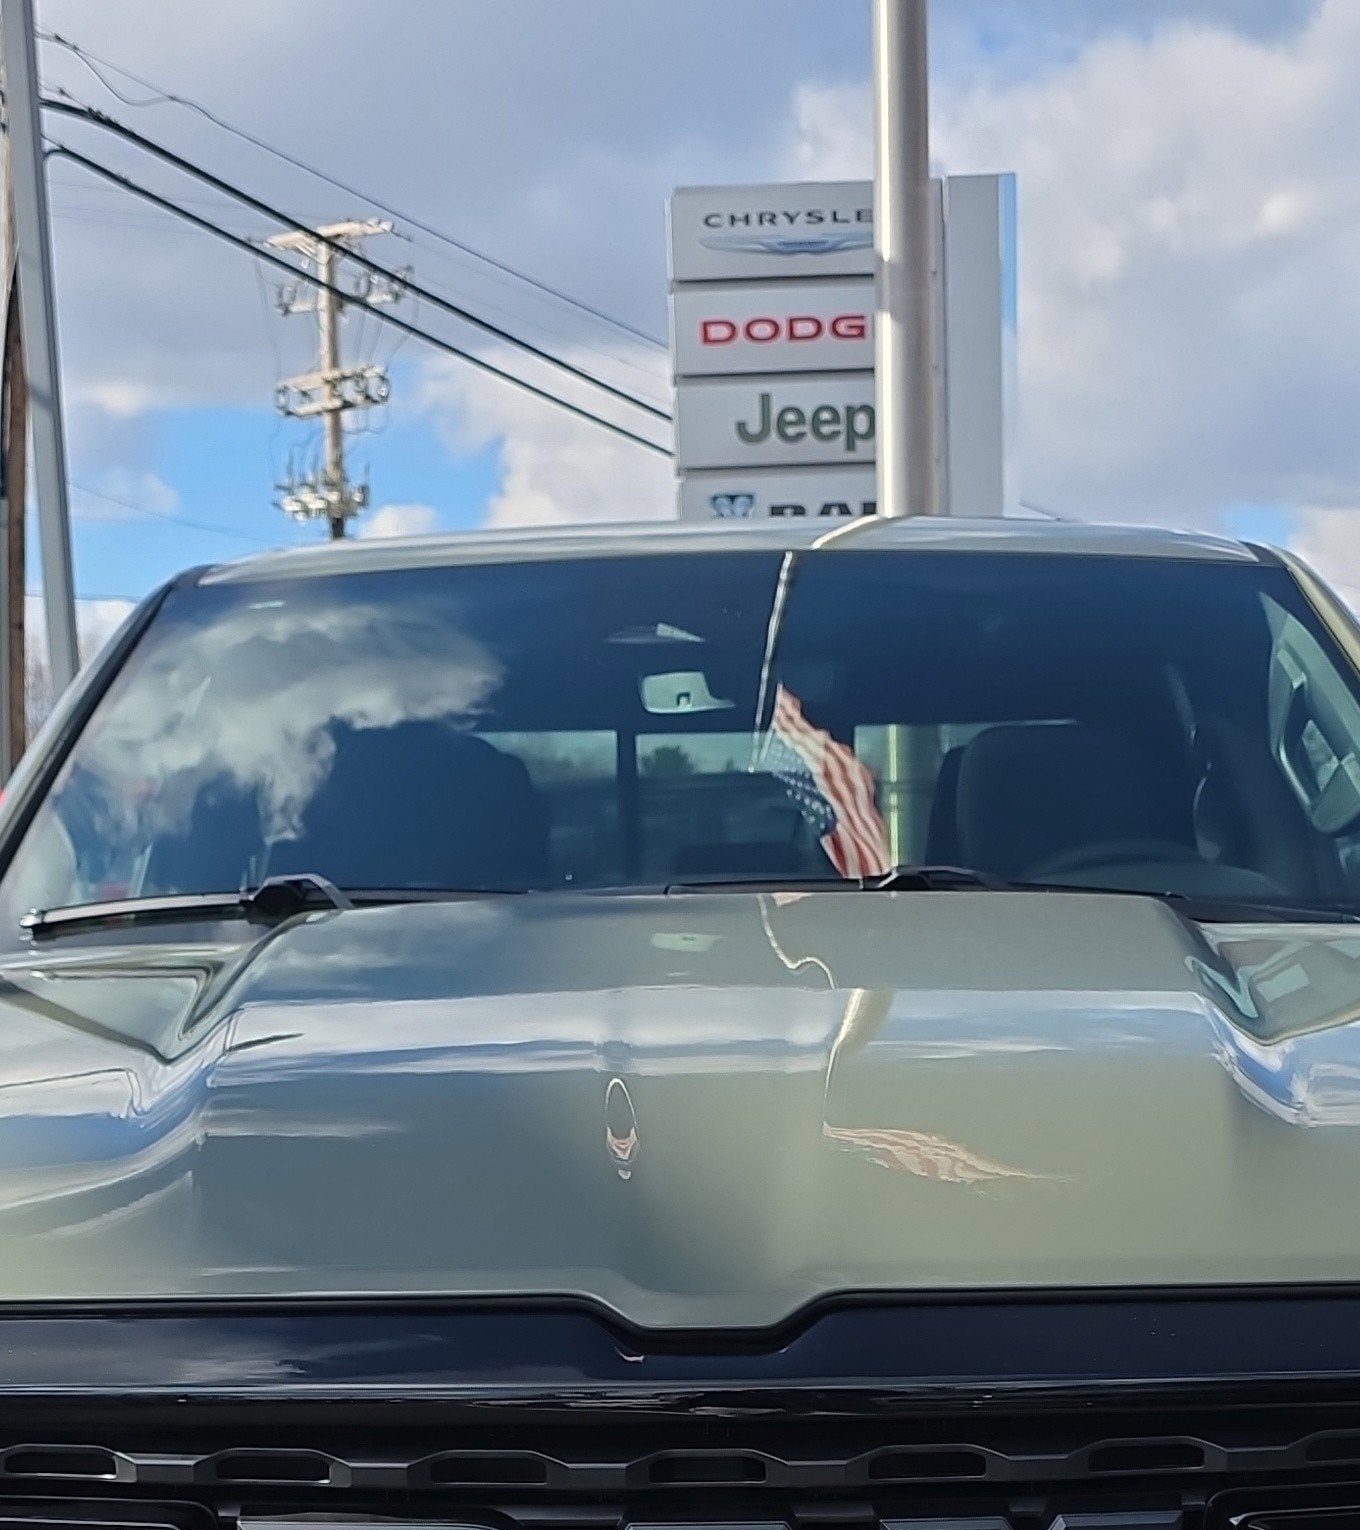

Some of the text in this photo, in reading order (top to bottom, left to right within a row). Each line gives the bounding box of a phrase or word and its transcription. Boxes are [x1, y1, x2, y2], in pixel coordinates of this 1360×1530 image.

[703, 208, 874, 227] CHRYSLE
[700, 315, 866, 345] DODG
[736, 393, 876, 452] Jeep
